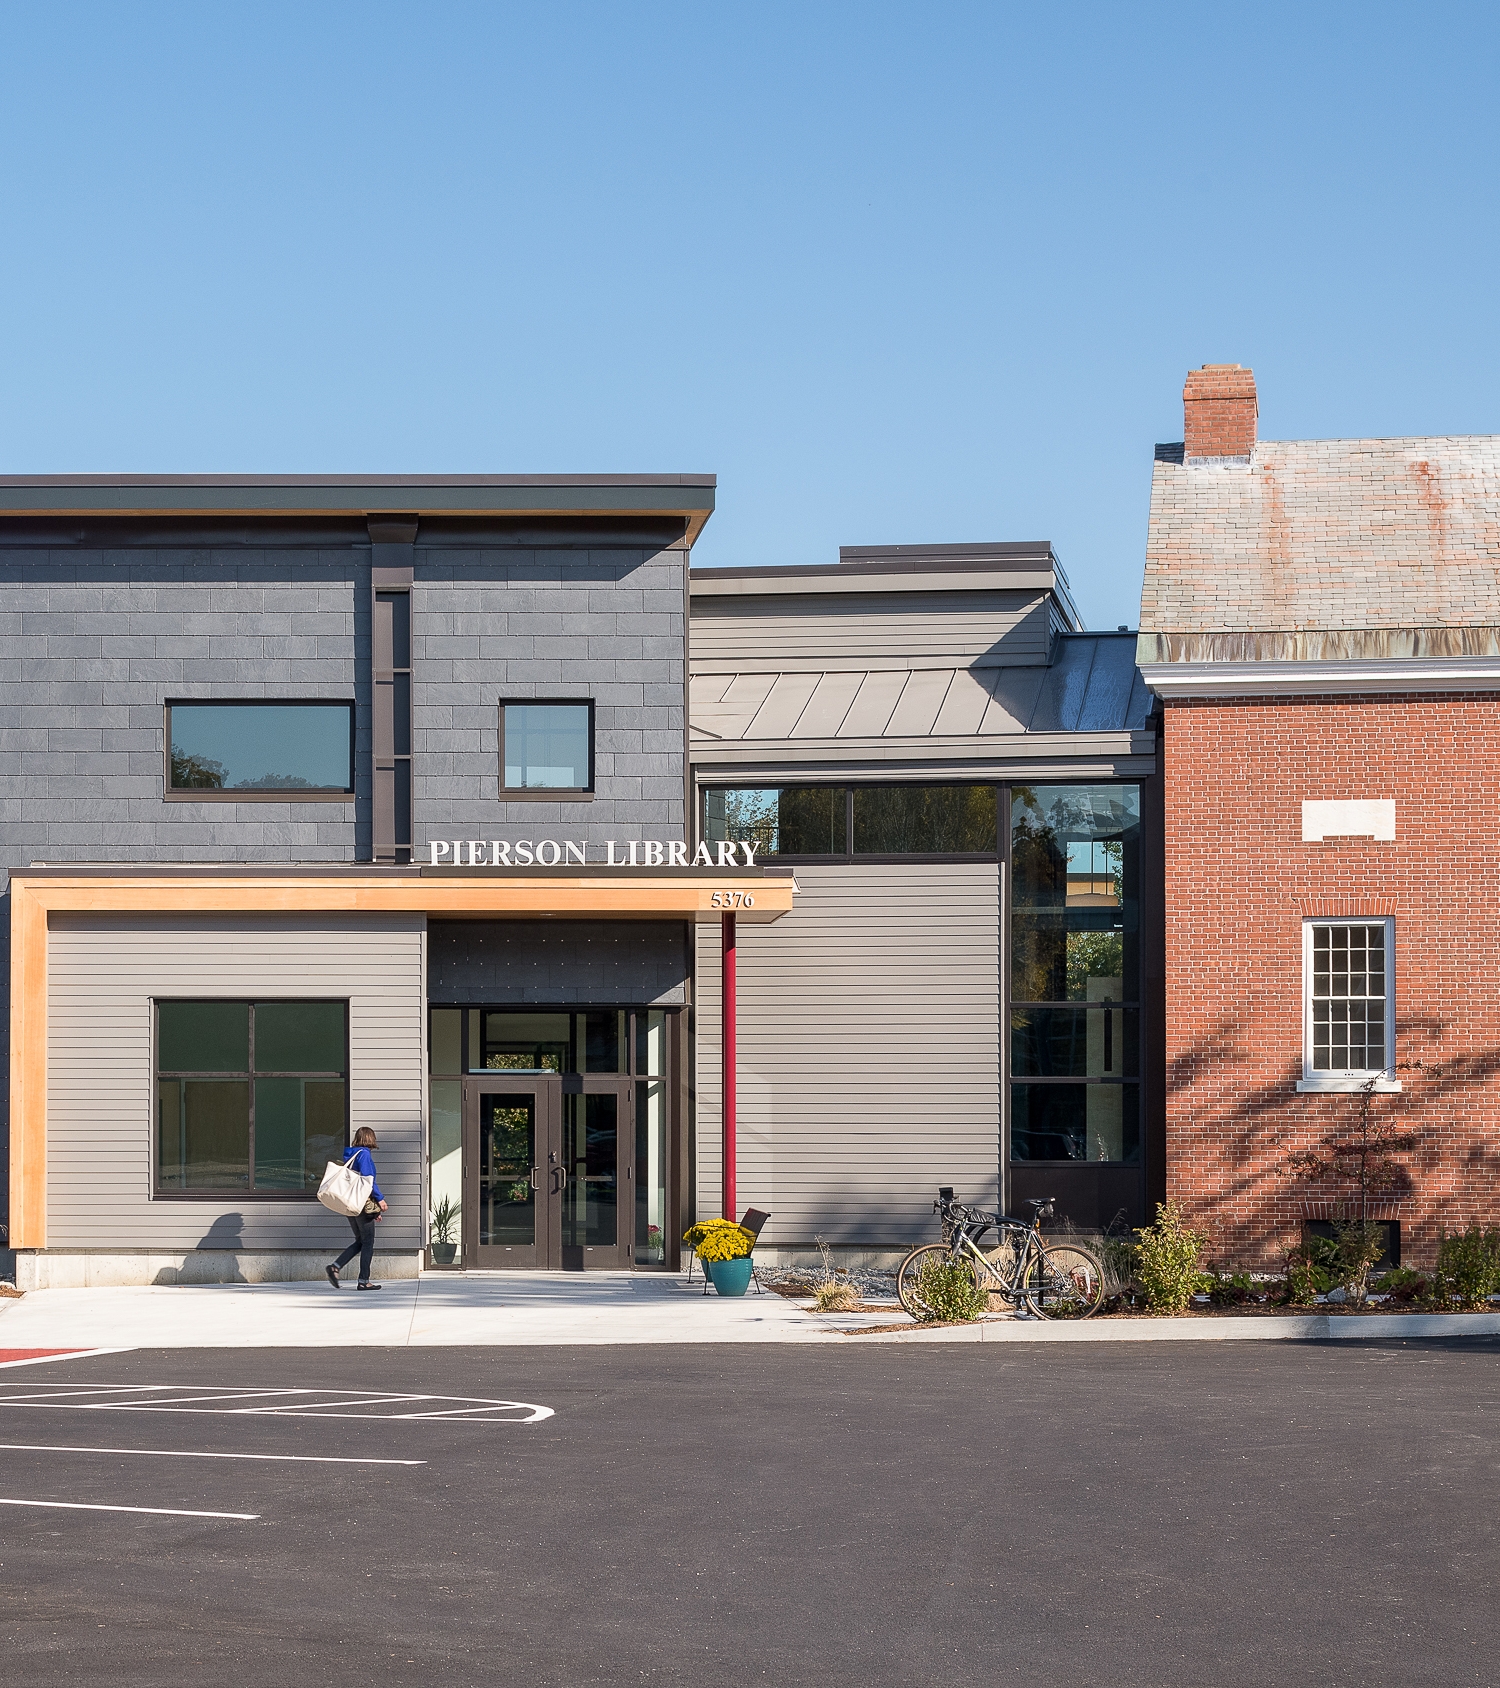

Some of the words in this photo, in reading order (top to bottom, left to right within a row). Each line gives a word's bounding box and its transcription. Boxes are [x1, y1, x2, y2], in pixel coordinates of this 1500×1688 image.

[427, 839, 588, 867] PIERSON
[604, 839, 762, 867] LIBRARY
[711, 891, 755, 908] 5376
